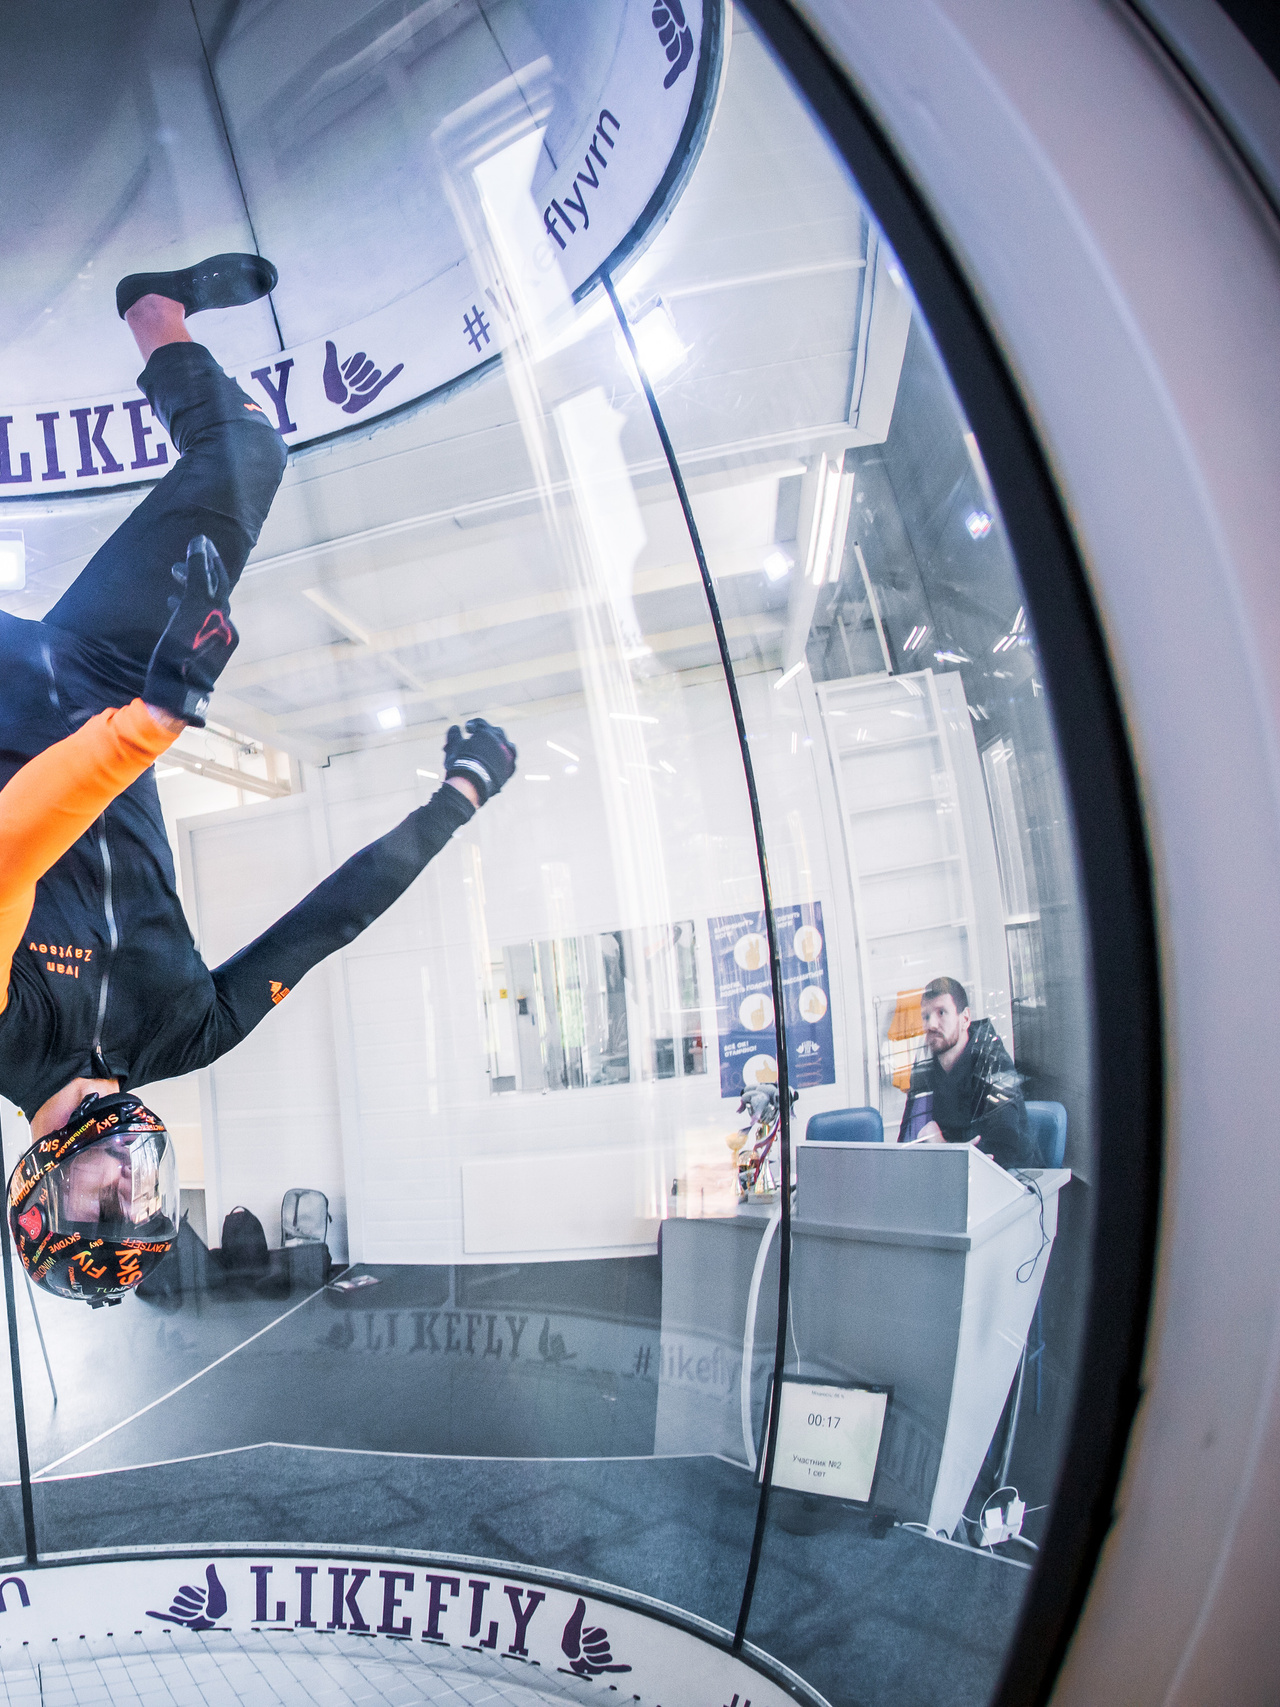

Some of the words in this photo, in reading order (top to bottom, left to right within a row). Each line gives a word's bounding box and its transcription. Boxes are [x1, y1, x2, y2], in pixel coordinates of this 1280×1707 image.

[29, 942, 93, 962] Zaytsev
[47, 962, 79, 979] Ivan
[96, 1113, 119, 1134] Sky
[48, 1232, 81, 1254] SKYDIVE
[71, 1250, 107, 1279] Fly
[115, 1249, 143, 1285] Sky
[808, 1413, 841, 1429] 00:17
[793, 1454, 826, 1467] Участник
[828, 1460, 842, 1470] №2
[250, 1565, 546, 1655] LIKEFLY
